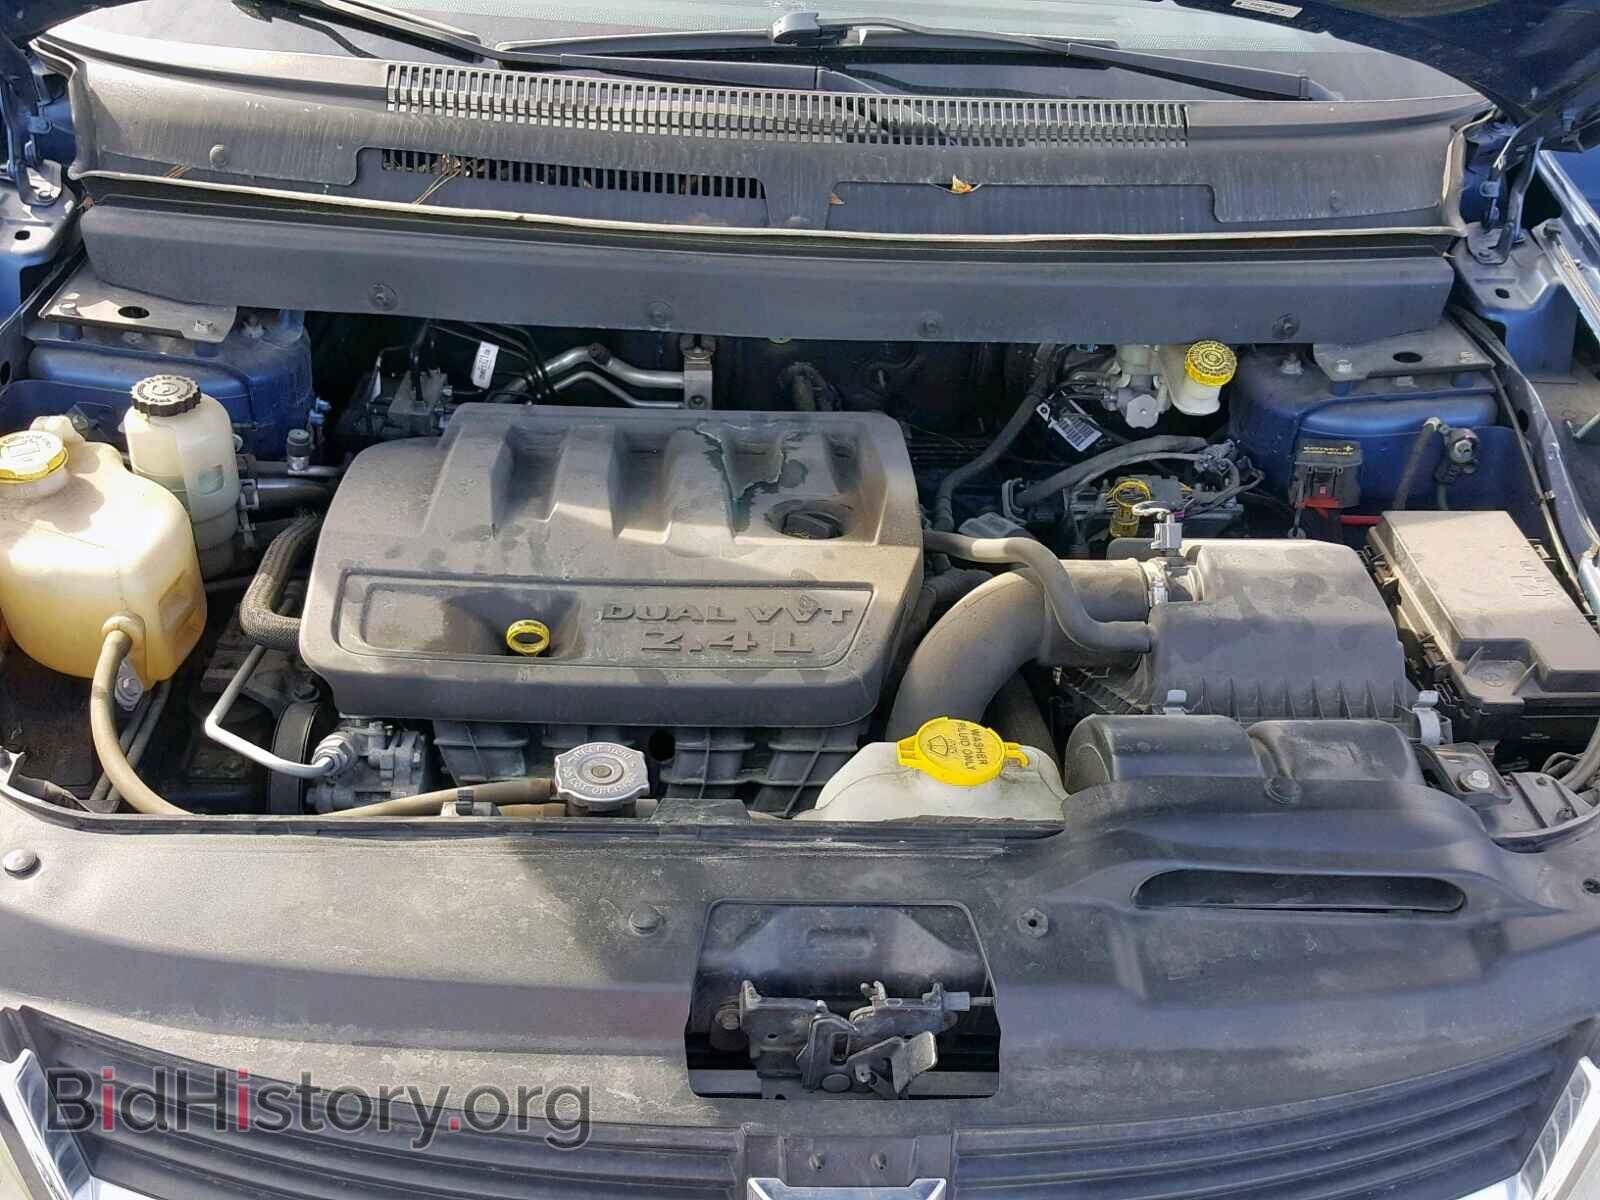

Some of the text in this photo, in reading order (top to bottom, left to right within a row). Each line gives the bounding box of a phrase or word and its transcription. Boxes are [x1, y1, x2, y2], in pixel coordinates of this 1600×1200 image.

[601, 602, 737, 623] DUAL
[641, 630, 814, 654] 2.4L
[958, 722, 976, 770] FLUID ONLY
[972, 729, 988, 765] WASHER
